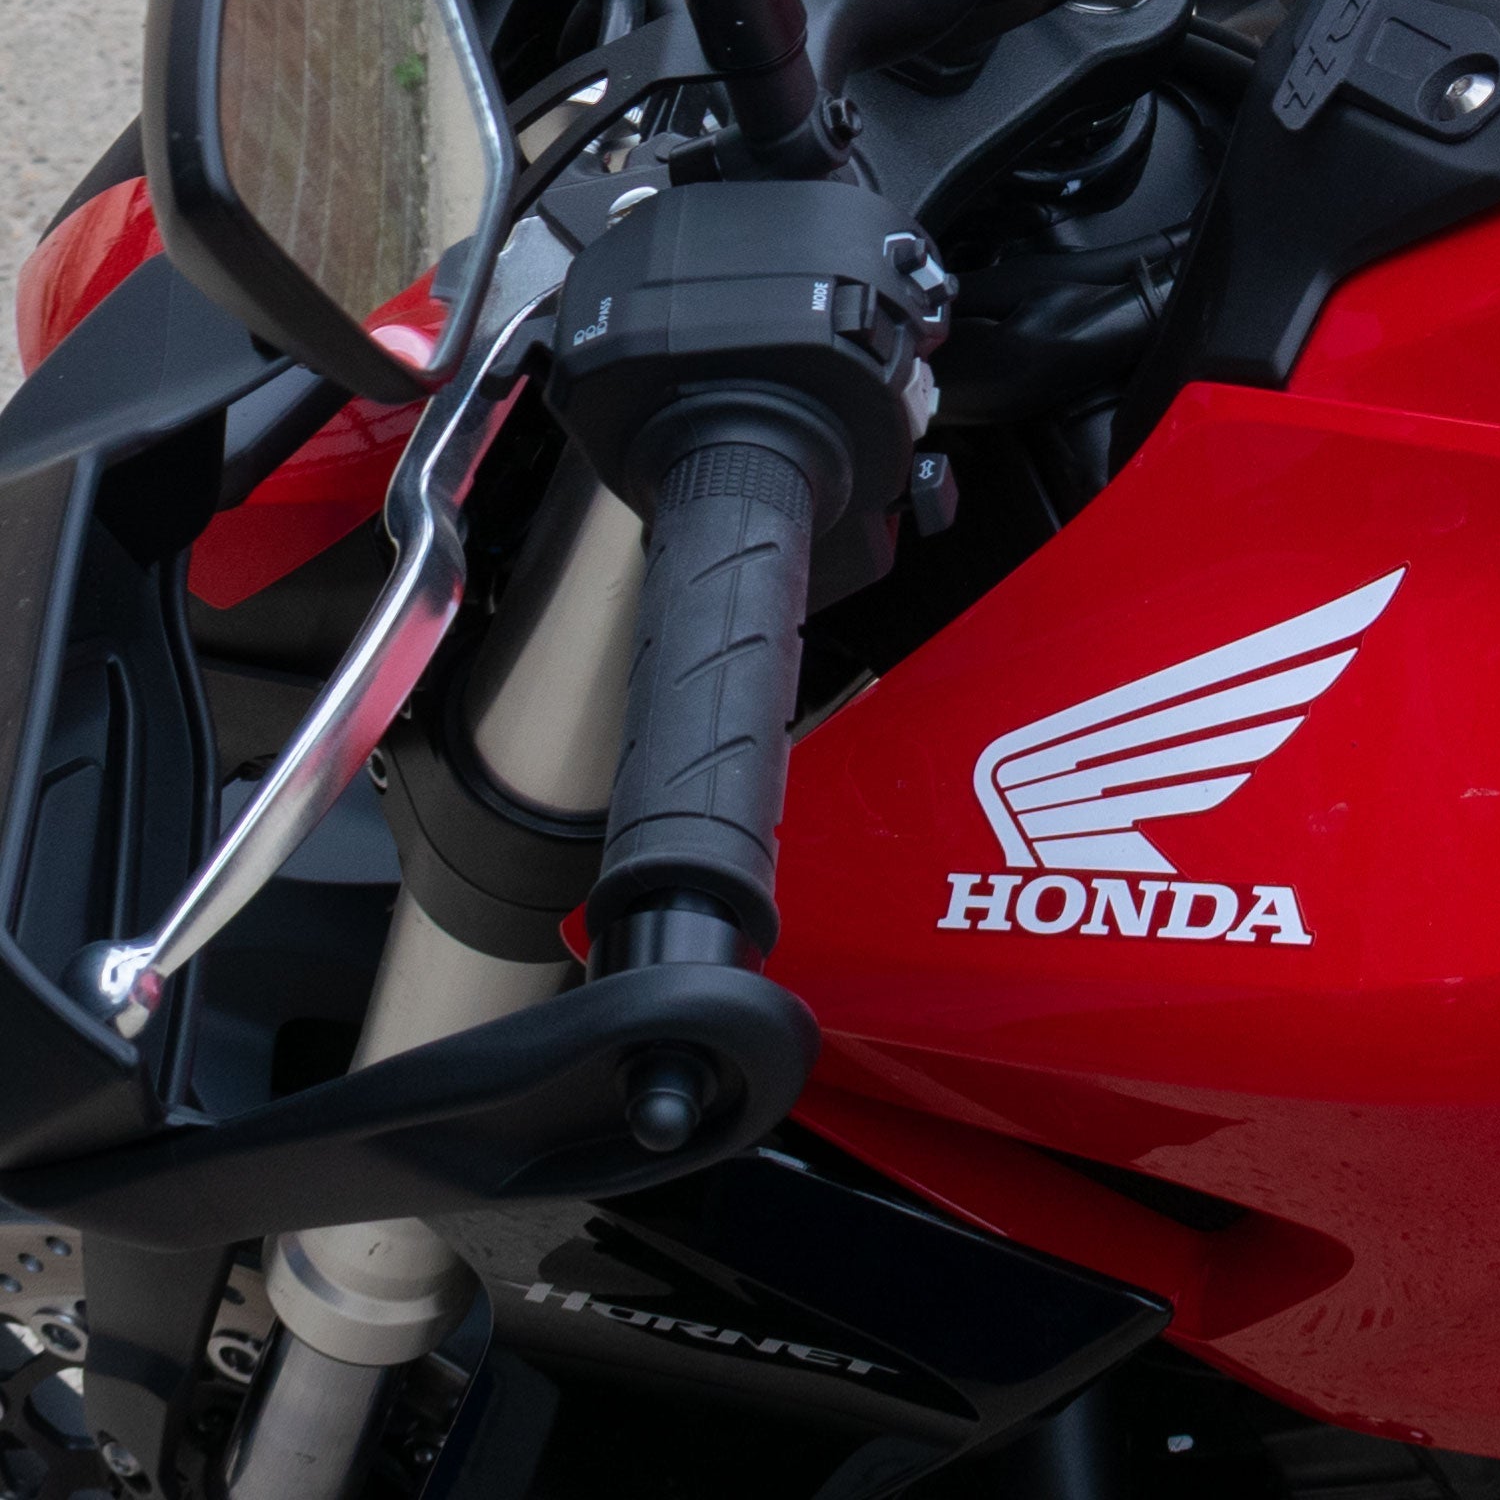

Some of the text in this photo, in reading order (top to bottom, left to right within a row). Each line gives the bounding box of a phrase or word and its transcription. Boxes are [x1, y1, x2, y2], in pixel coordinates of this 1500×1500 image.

[601, 296, 612, 327] PASS
[811, 281, 829, 312] MODE
[937, 872, 1313, 946] HONDA
[515, 1281, 900, 1376] HORNET
